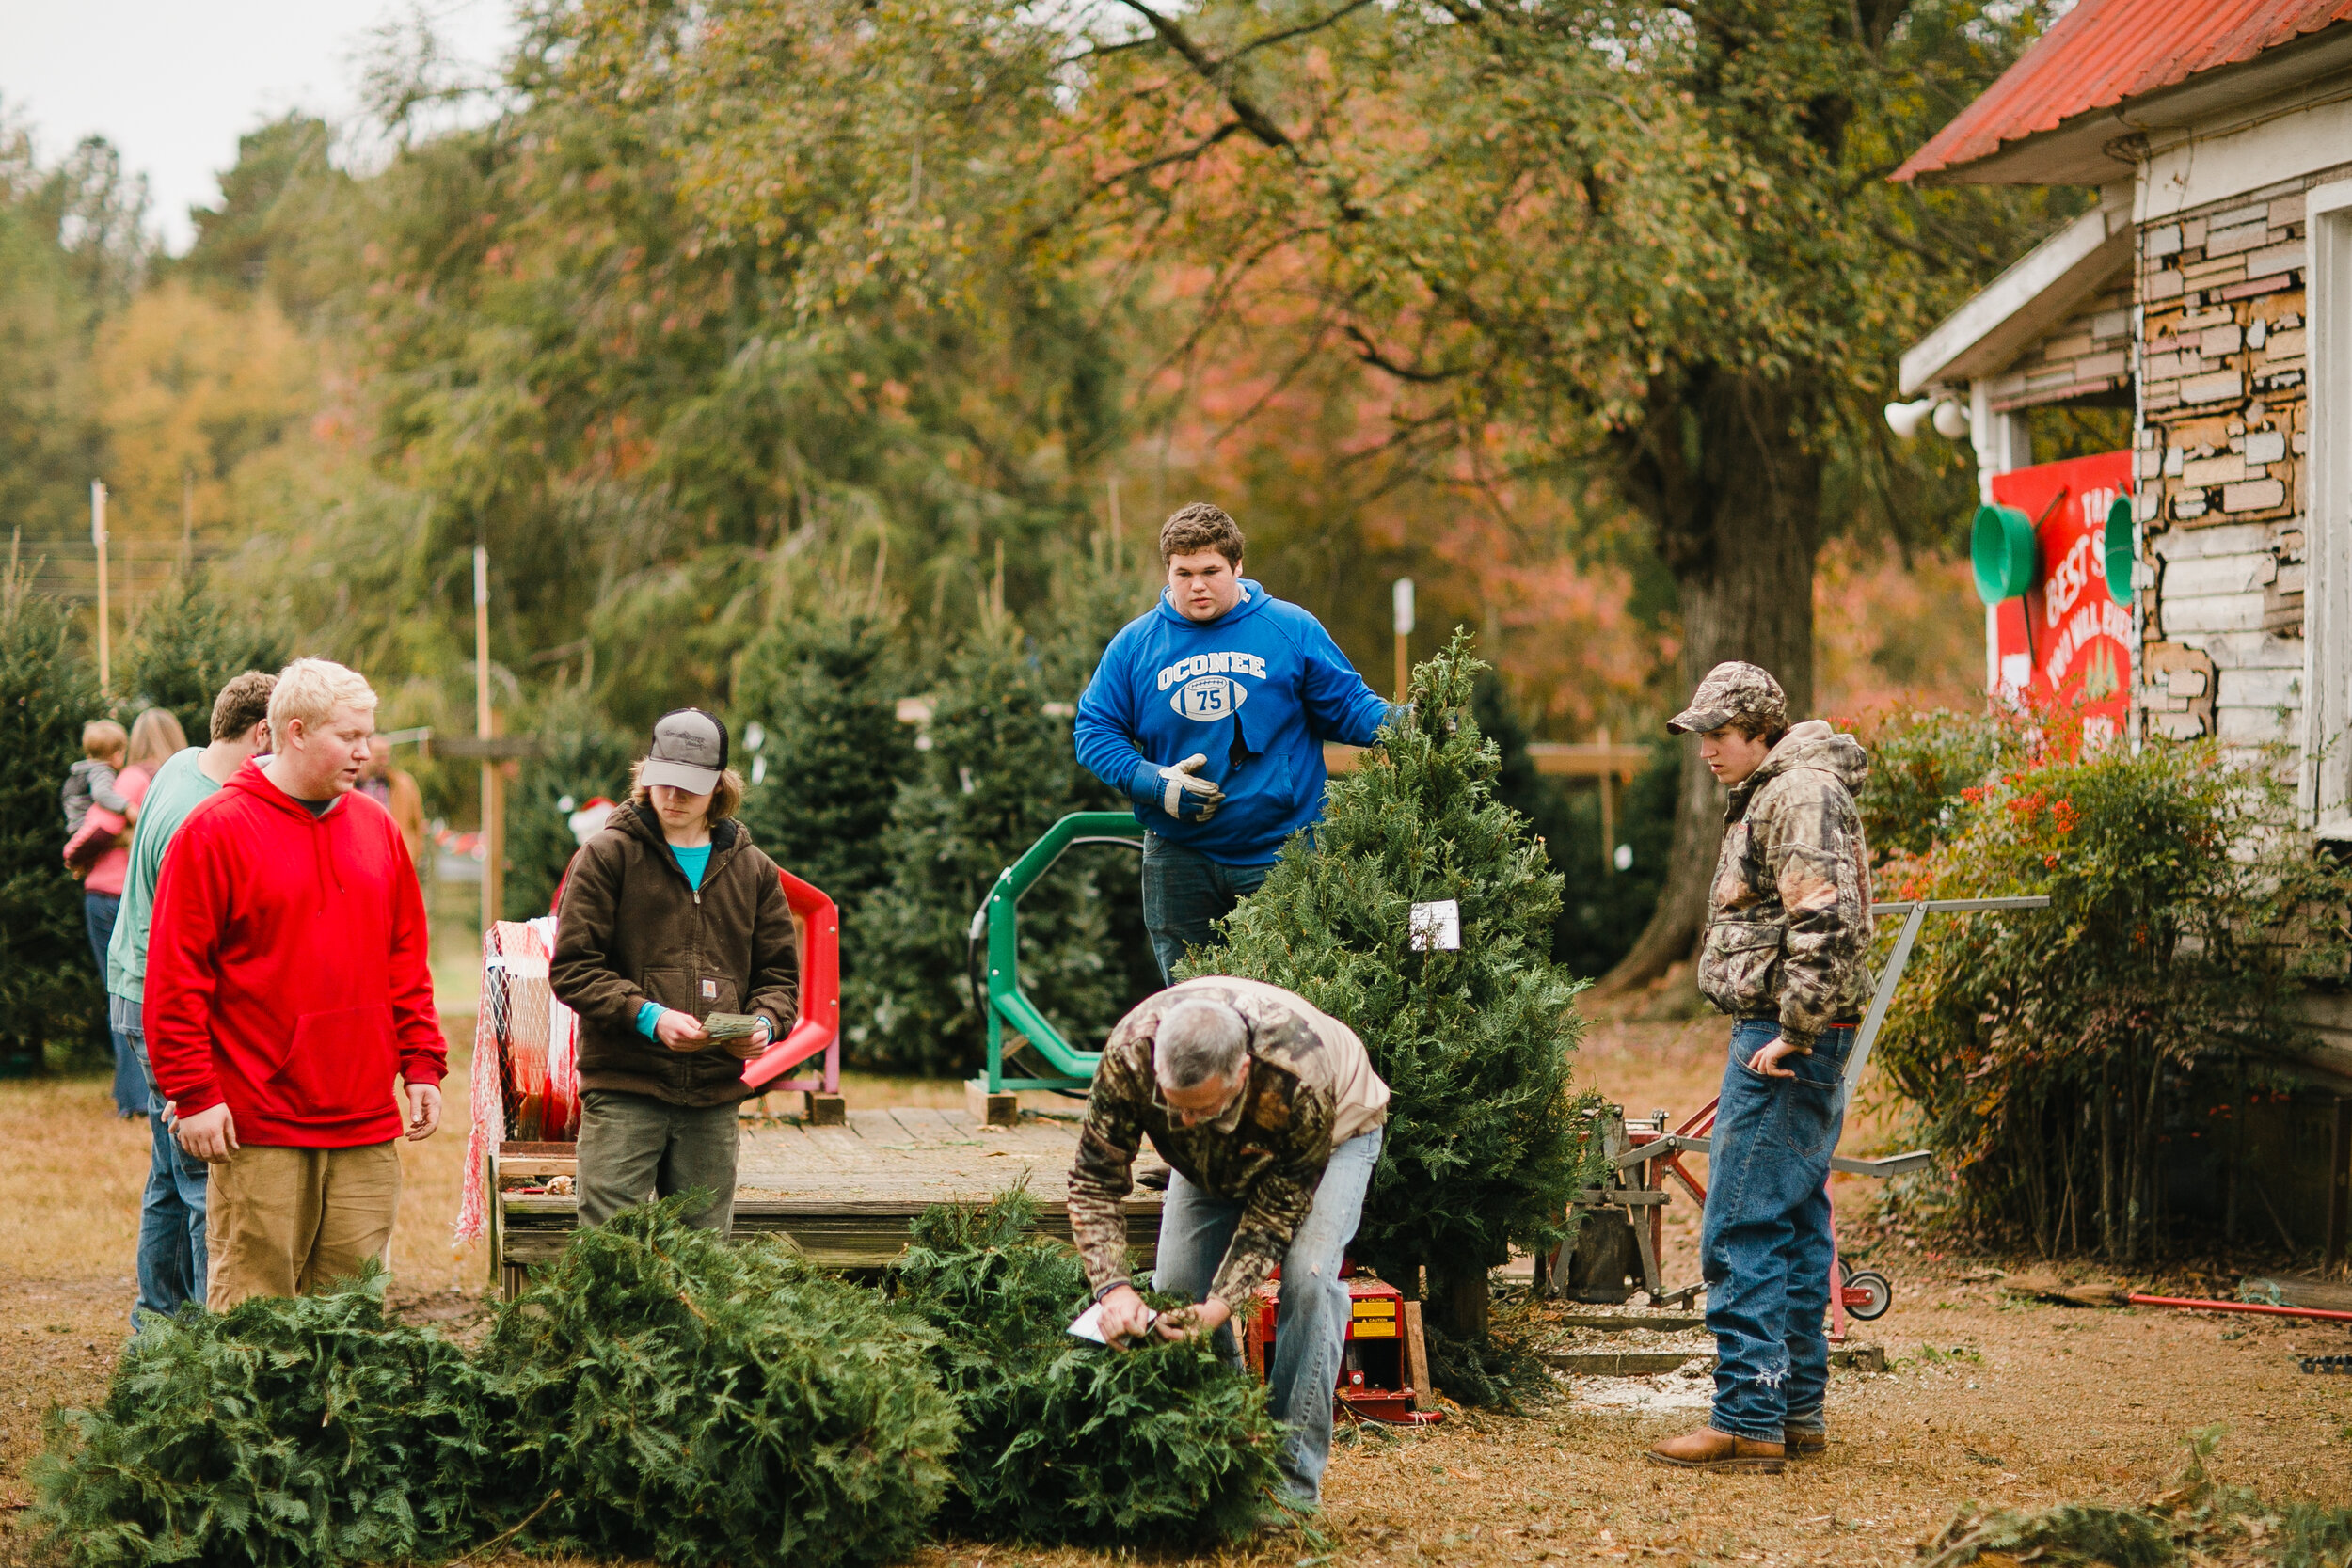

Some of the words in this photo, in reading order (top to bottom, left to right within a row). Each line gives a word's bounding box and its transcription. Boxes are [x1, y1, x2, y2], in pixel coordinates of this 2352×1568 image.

[2044, 534, 2090, 629] BEST
[1157, 651, 1267, 691] OCONEE
[2046, 628, 2073, 693] YOU
[2070, 601, 2102, 653] WILL
[1197, 690, 1222, 711] 75
